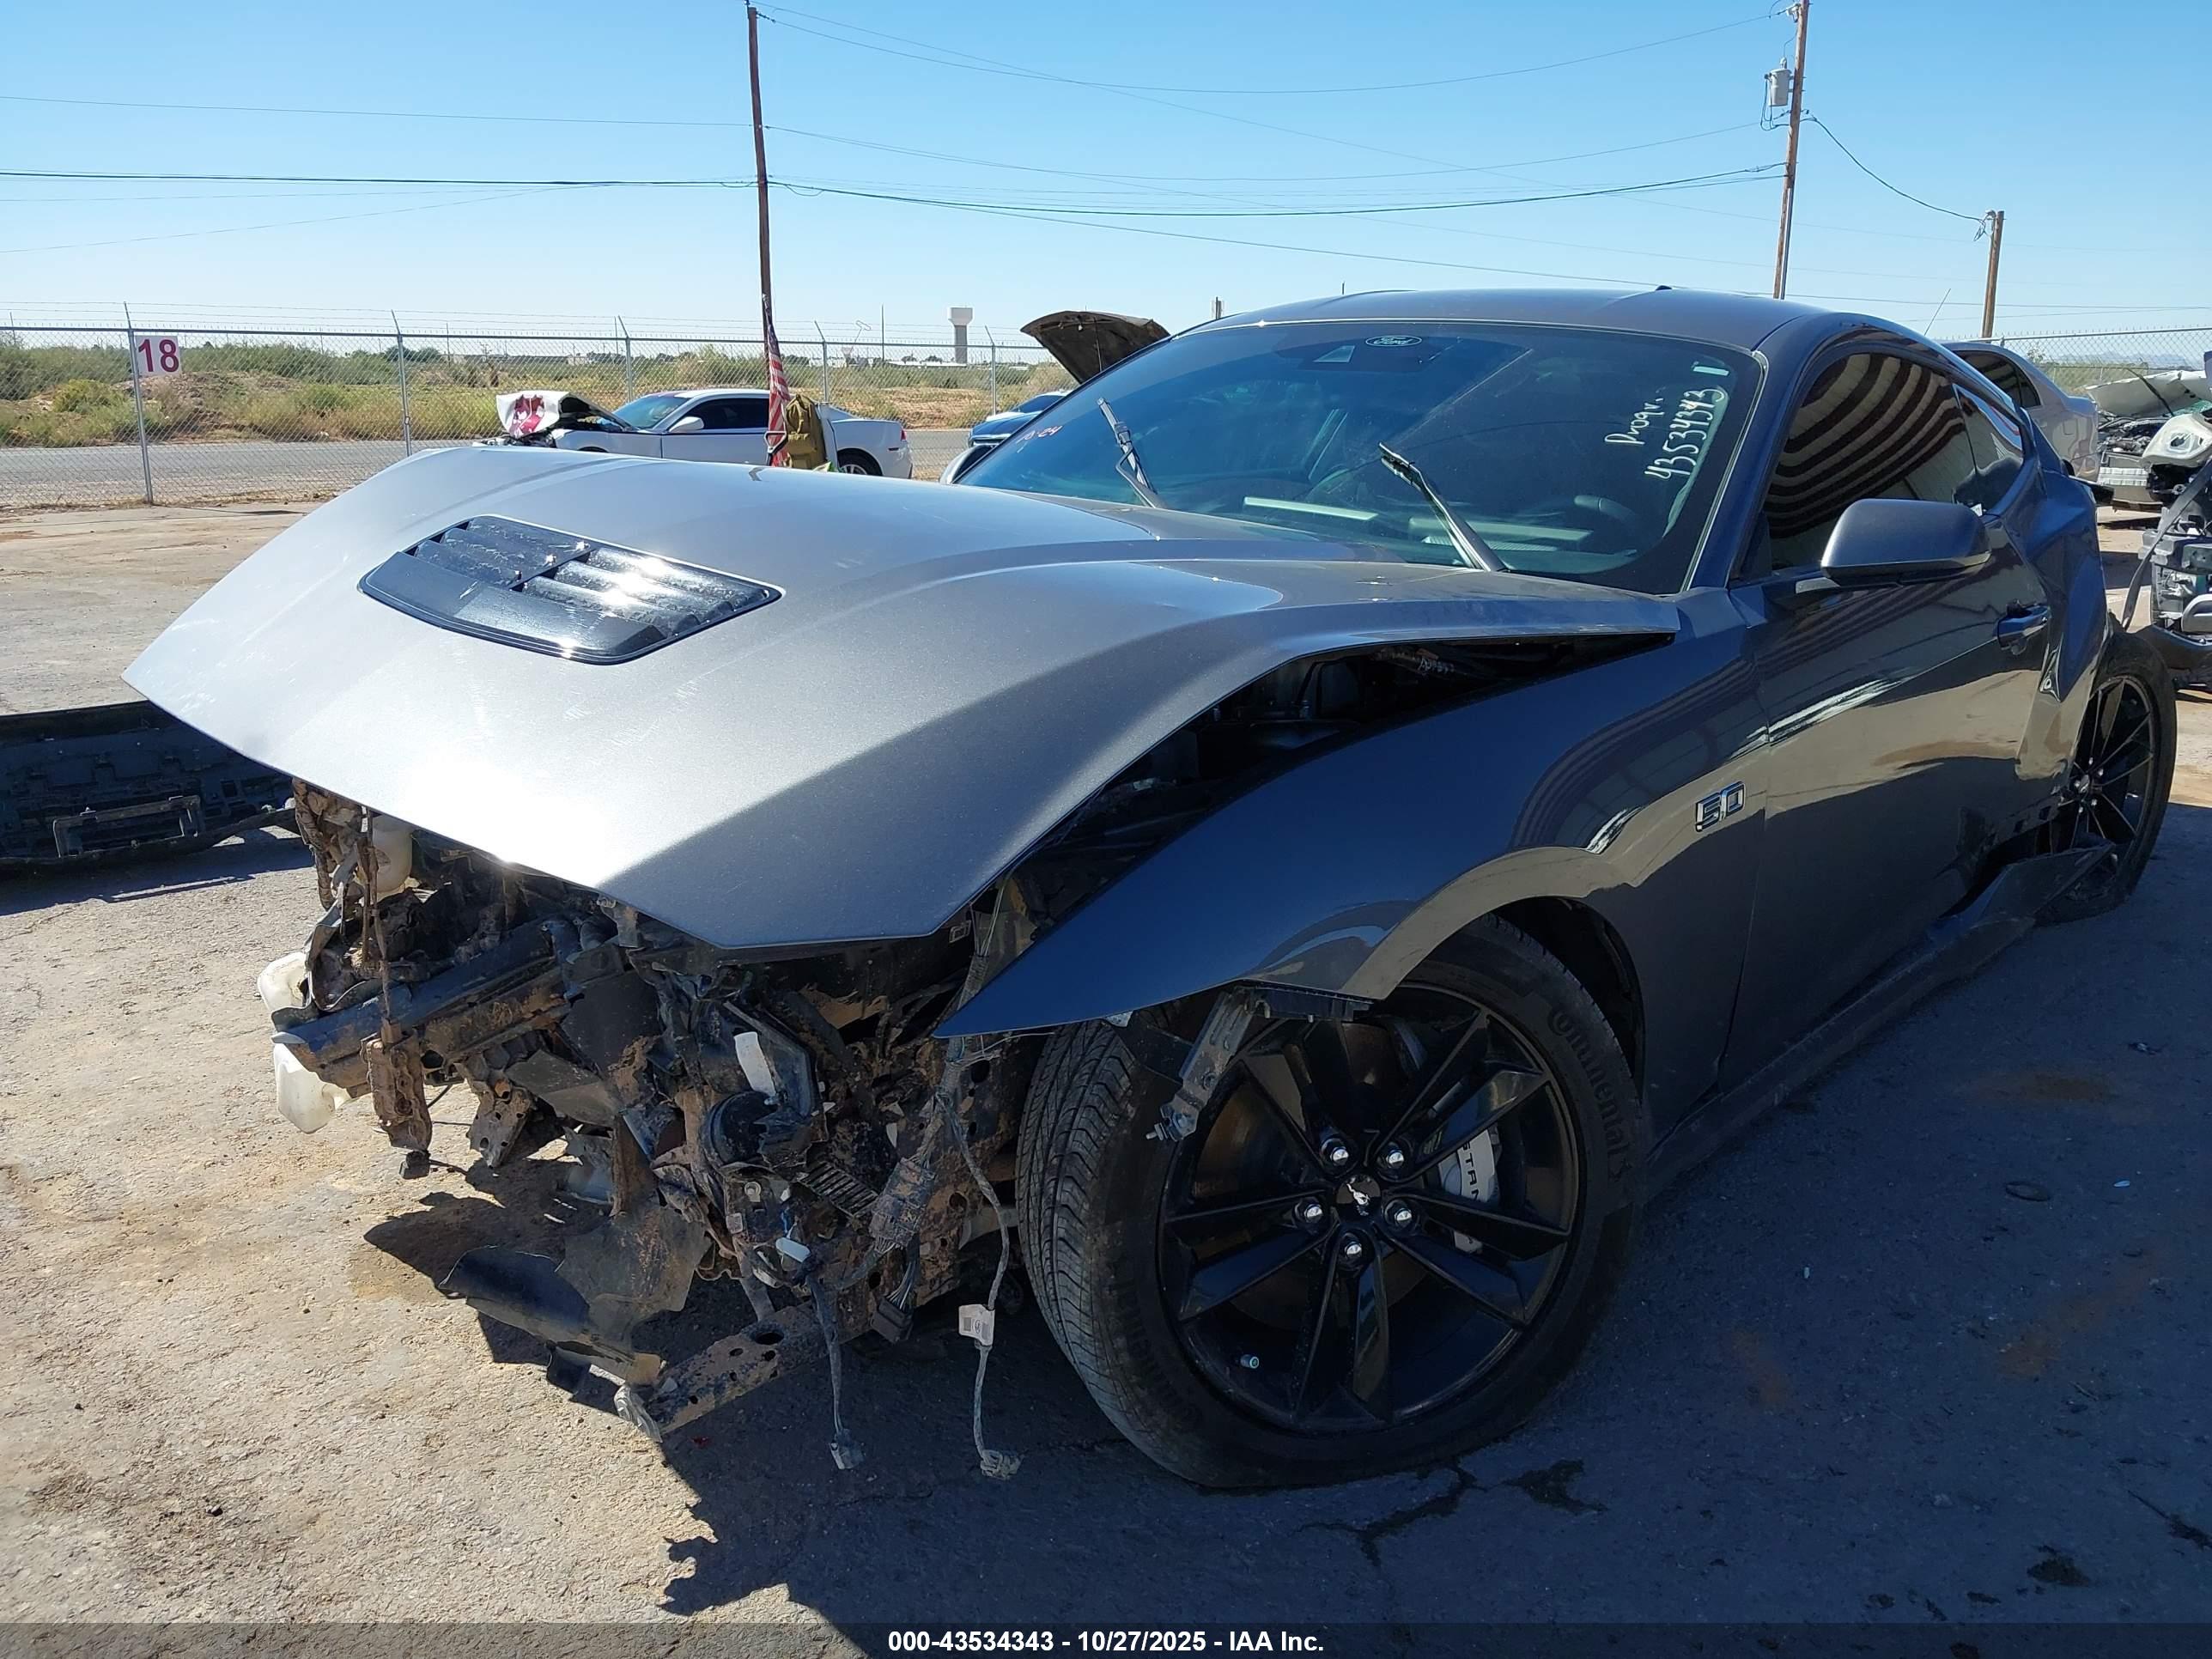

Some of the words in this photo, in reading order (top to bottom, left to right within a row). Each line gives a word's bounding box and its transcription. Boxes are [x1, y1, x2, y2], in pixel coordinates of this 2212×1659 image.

[137, 338, 179, 373] 18
[1372, 336, 1415, 345] Ford
[1644, 388, 1726, 481] 43534343
[1547, 1002, 1631, 1156] Continental
